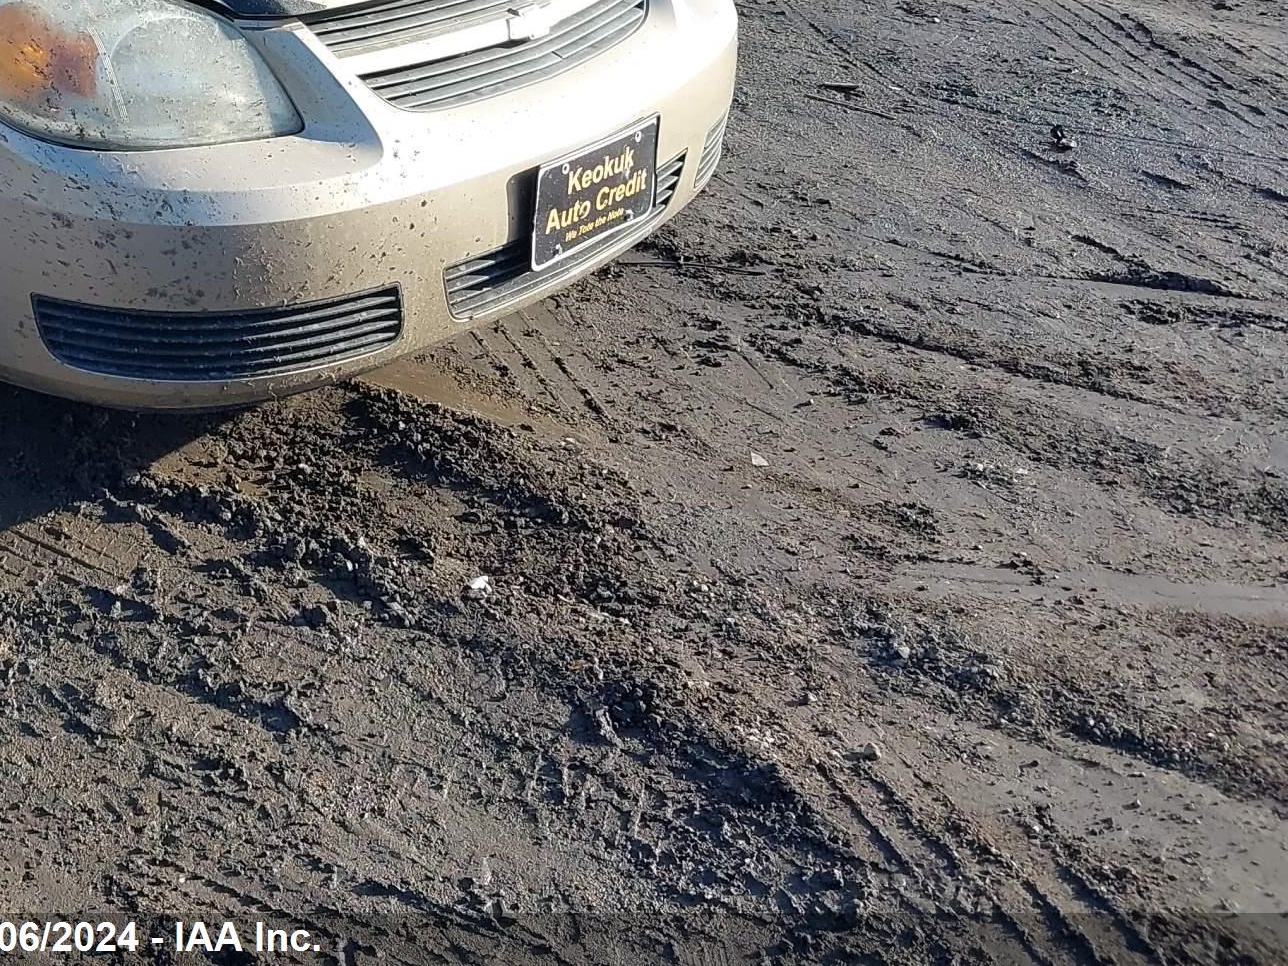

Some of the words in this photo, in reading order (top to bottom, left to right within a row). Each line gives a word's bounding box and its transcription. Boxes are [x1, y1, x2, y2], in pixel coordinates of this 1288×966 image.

[568, 146, 634, 195] Keokuk
[545, 200, 591, 235] Auto
[596, 168, 647, 211] Credit
